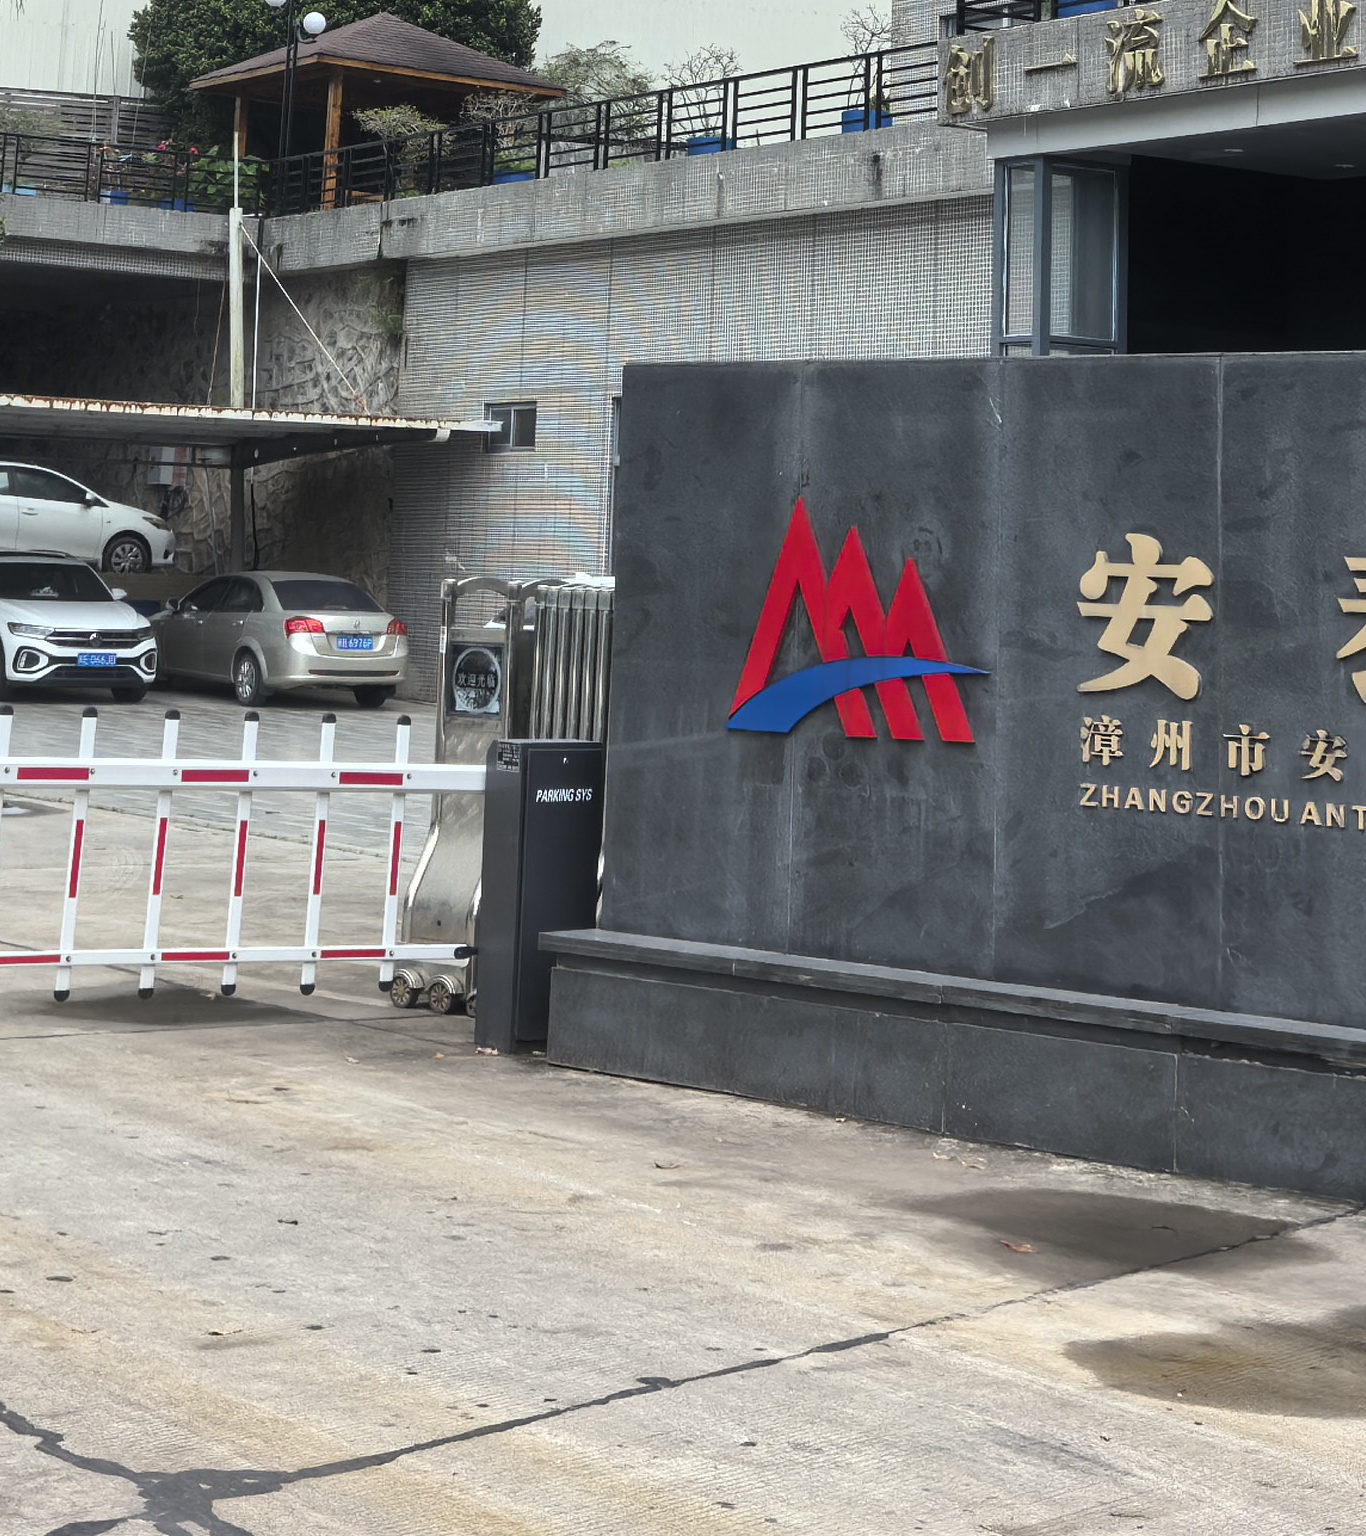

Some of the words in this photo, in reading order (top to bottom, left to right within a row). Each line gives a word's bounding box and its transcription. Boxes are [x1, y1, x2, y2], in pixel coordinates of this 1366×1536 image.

[535, 788, 575, 803] PARKING
[575, 788, 593, 802] SYS
[1078, 782, 1291, 824] ZHANGZHOU
